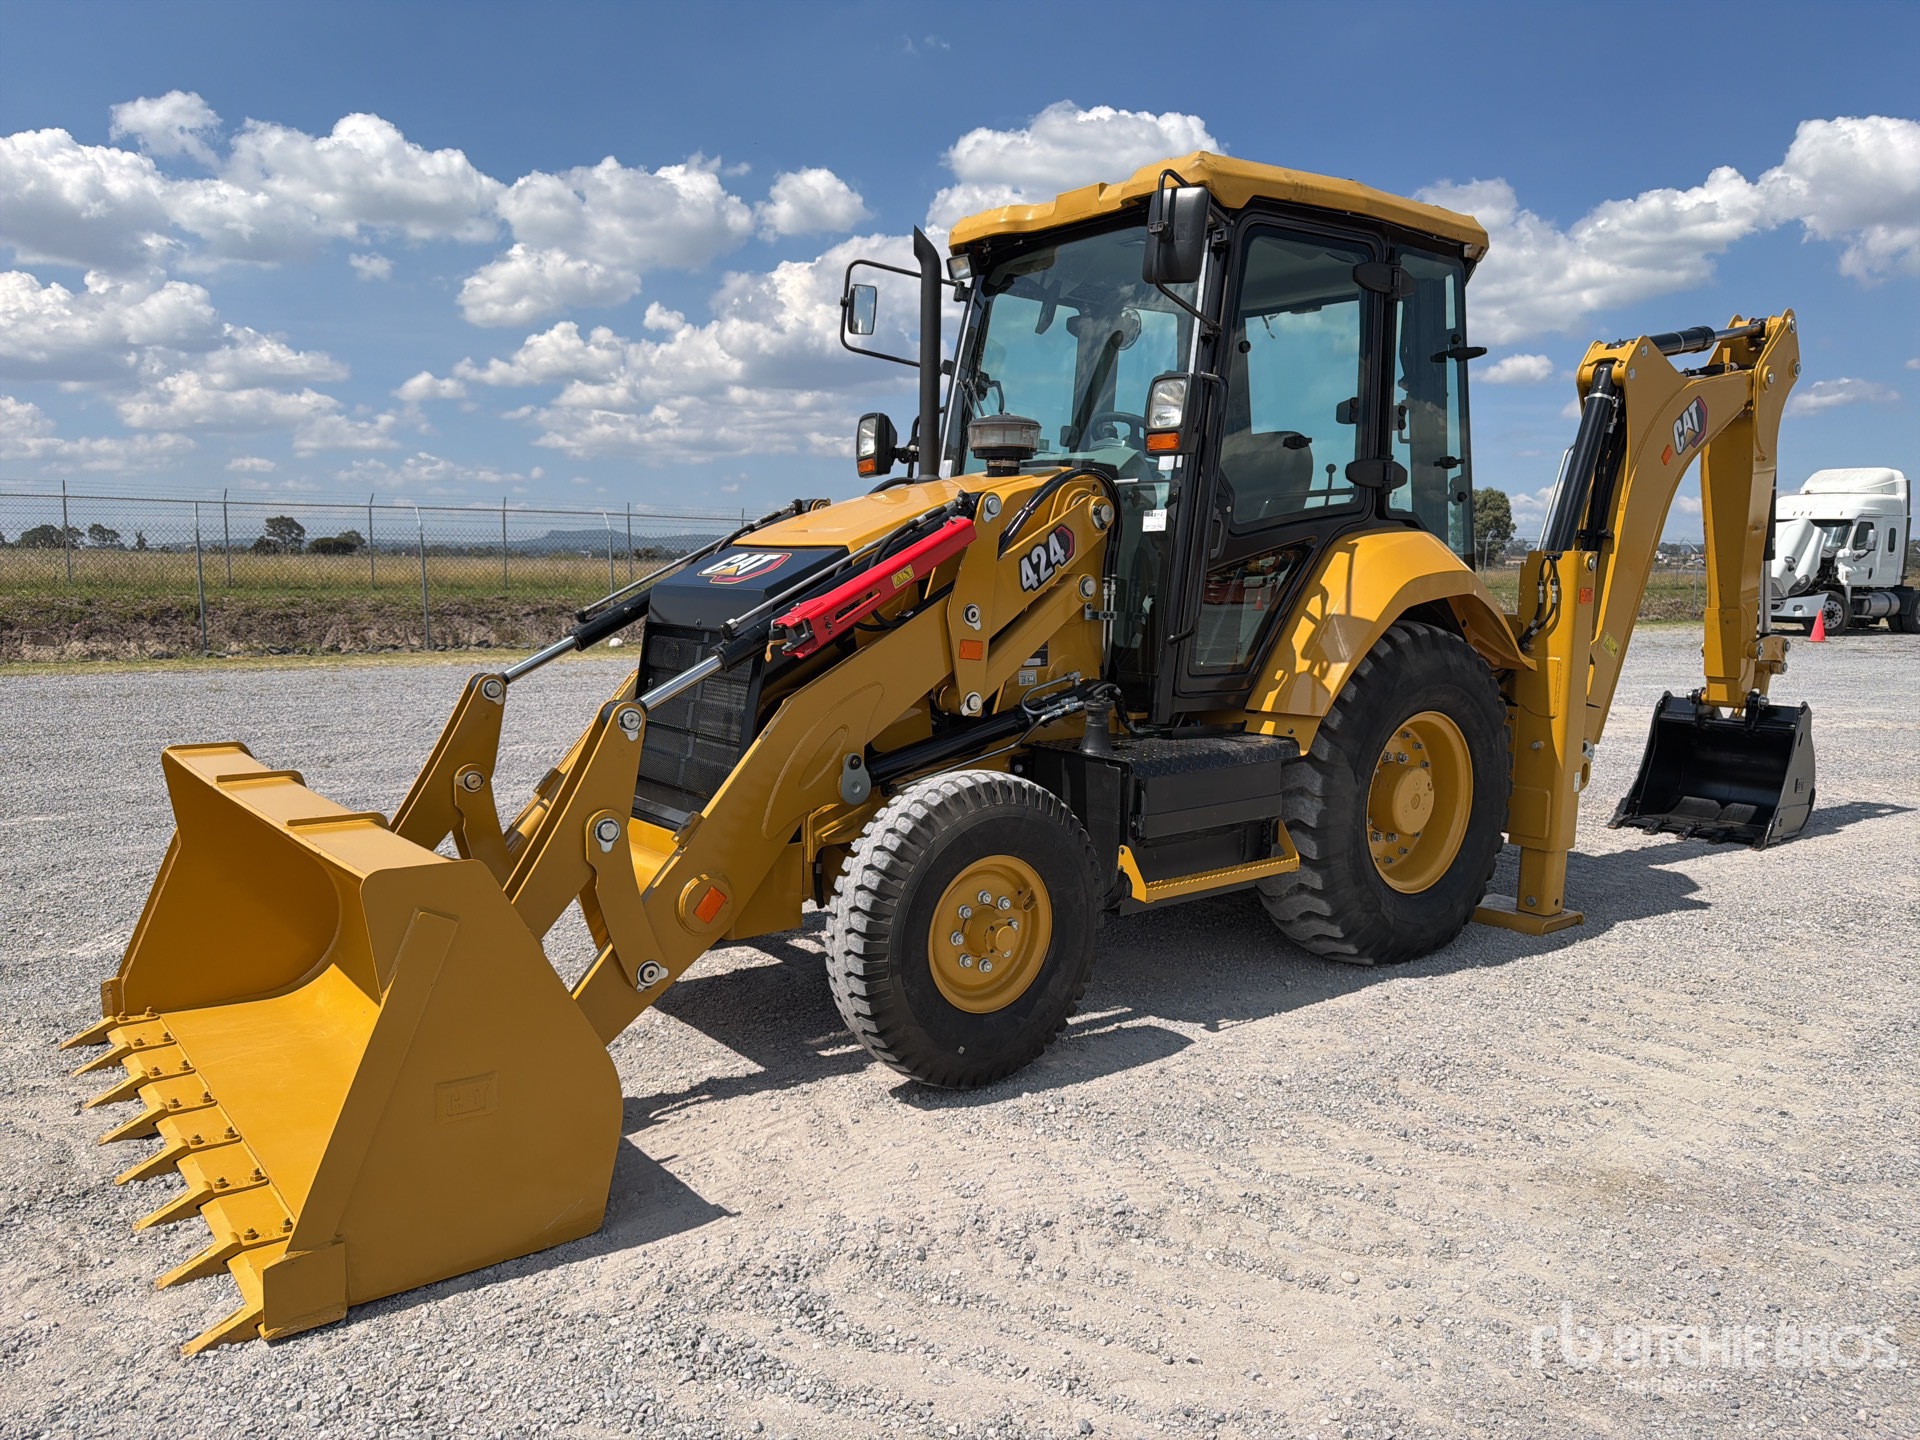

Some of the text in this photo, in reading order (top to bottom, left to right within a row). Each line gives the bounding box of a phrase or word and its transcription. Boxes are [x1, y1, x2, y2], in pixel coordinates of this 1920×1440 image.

[1673, 399, 1700, 455] CAT
[701, 553, 783, 576] CAT
[1020, 531, 1066, 590] 424
